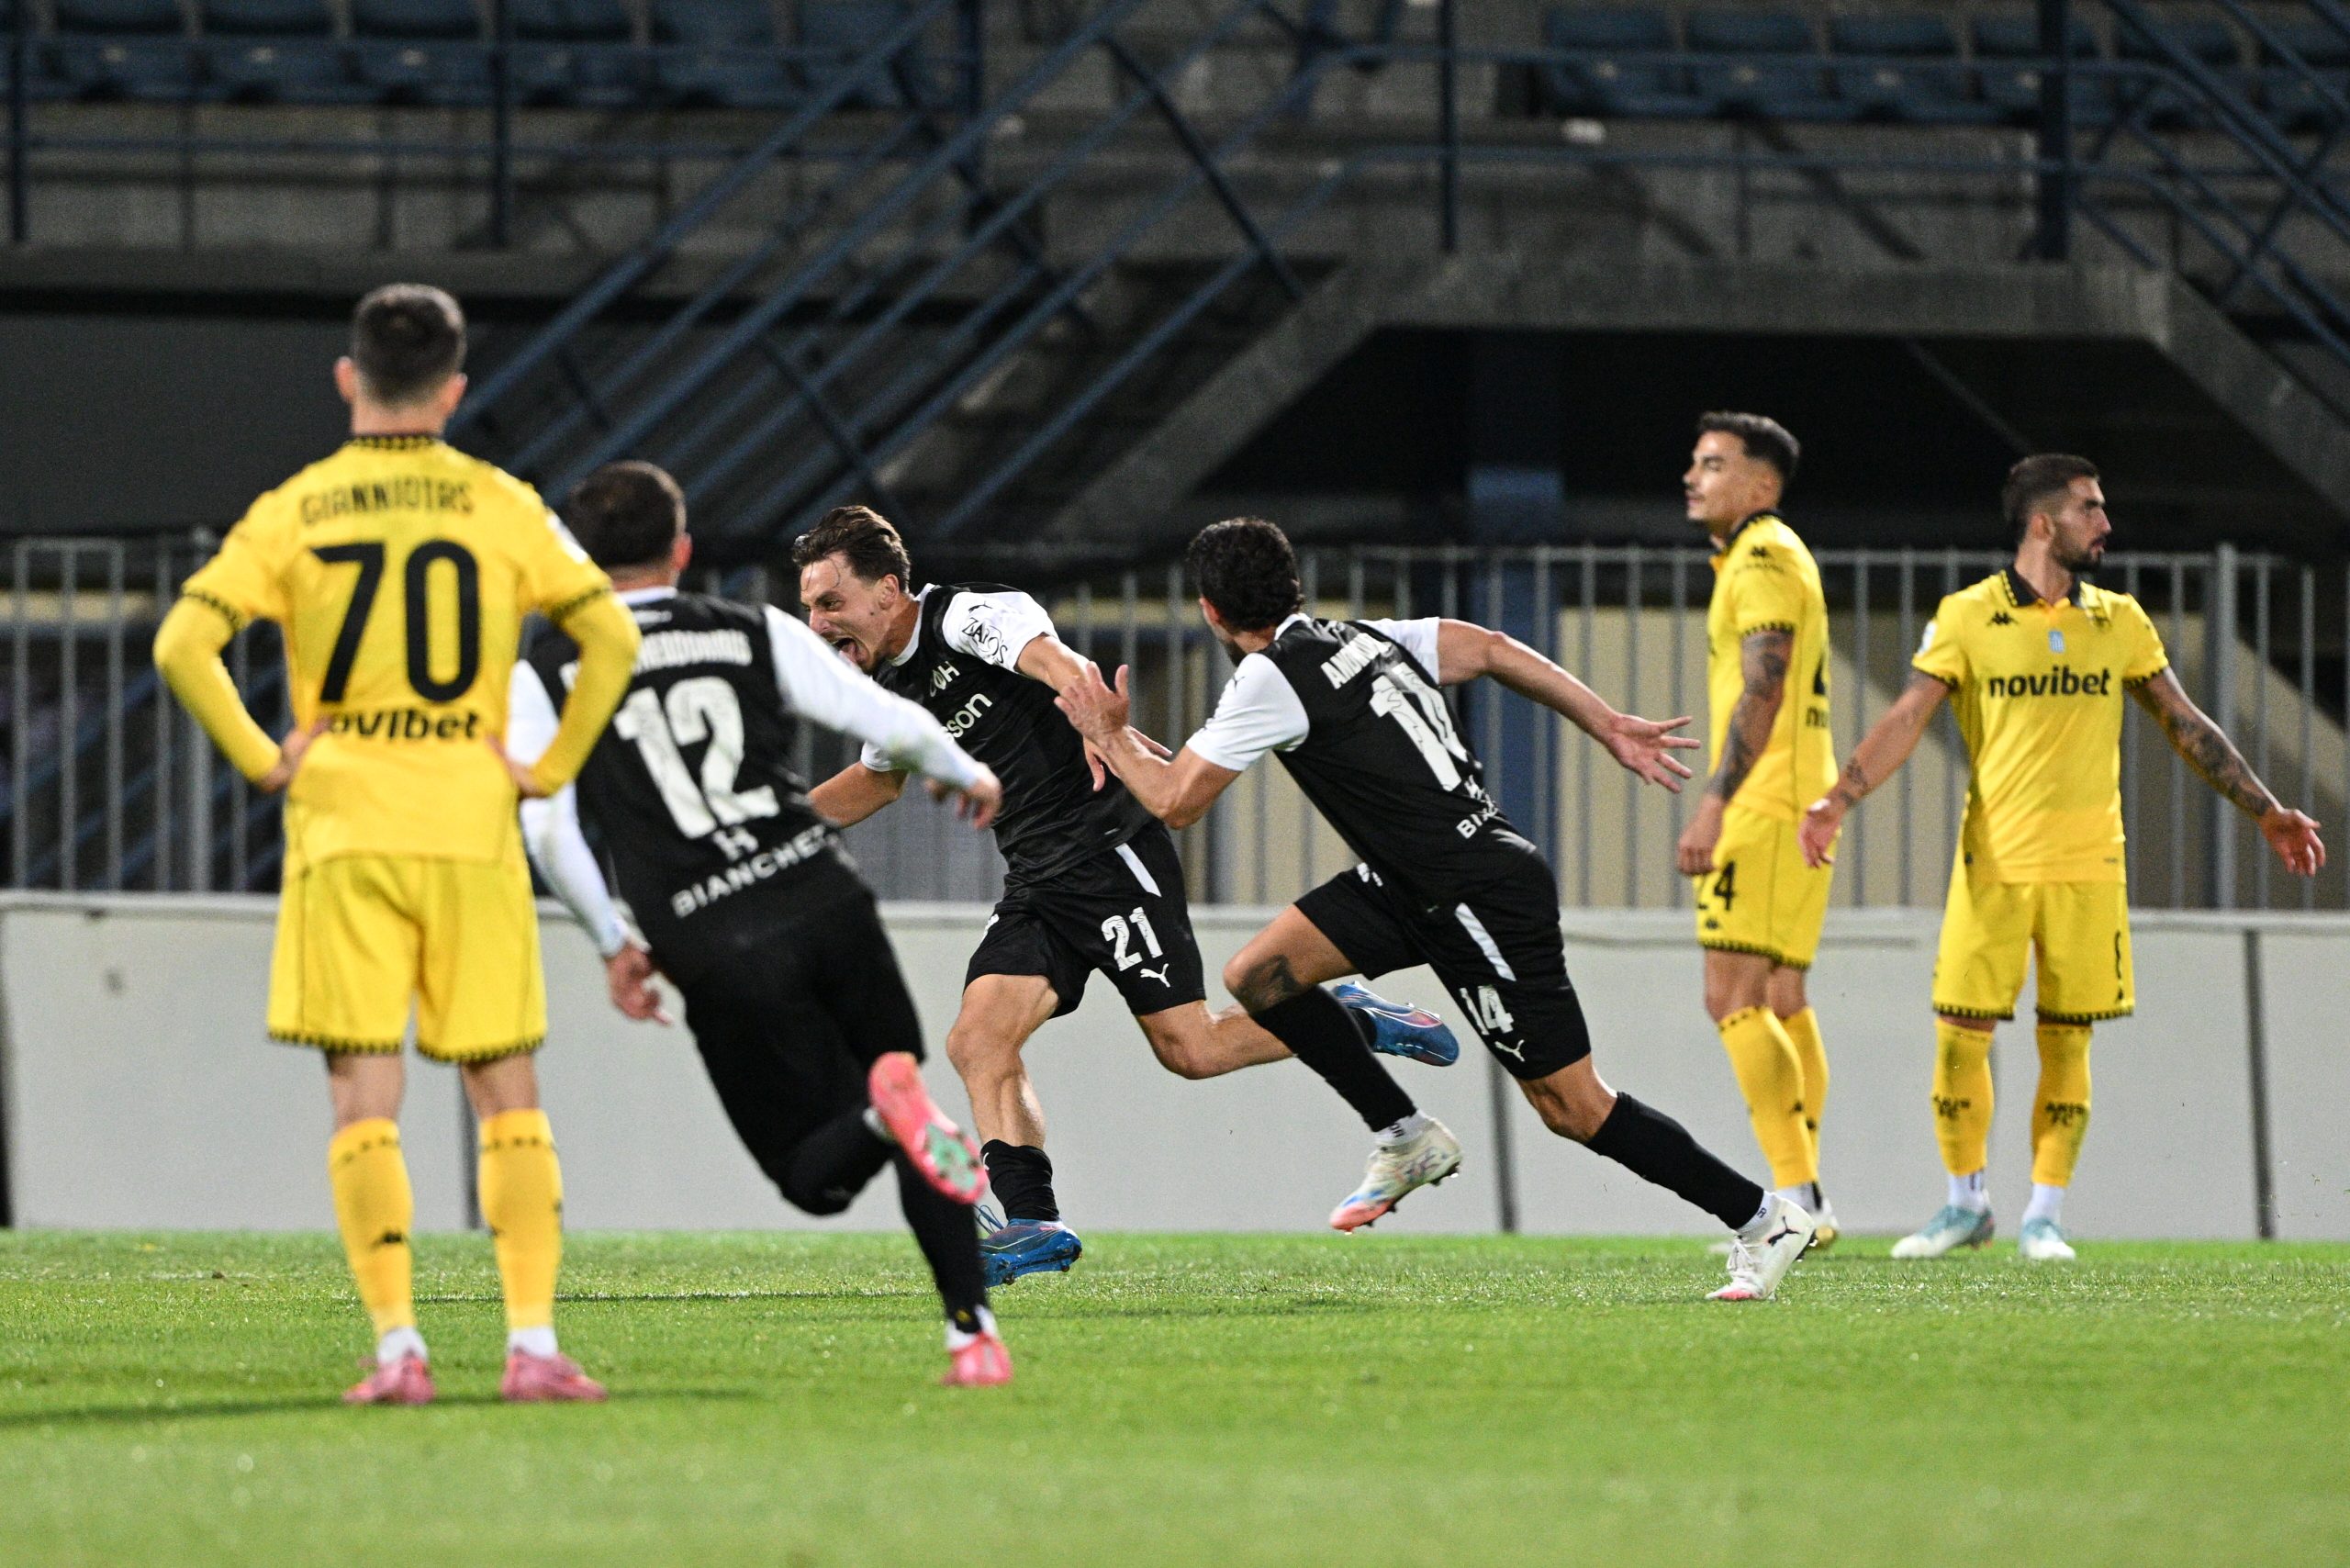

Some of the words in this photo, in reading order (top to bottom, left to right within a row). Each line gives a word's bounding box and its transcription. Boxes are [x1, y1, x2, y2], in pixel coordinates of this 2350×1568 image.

[307, 539, 482, 703] 70
[1989, 665, 2111, 698] novibet
[331, 709, 479, 741] ovibet
[612, 675, 780, 839] 12
[1101, 906, 1164, 972] 21
[1460, 985, 1515, 1036] 14
